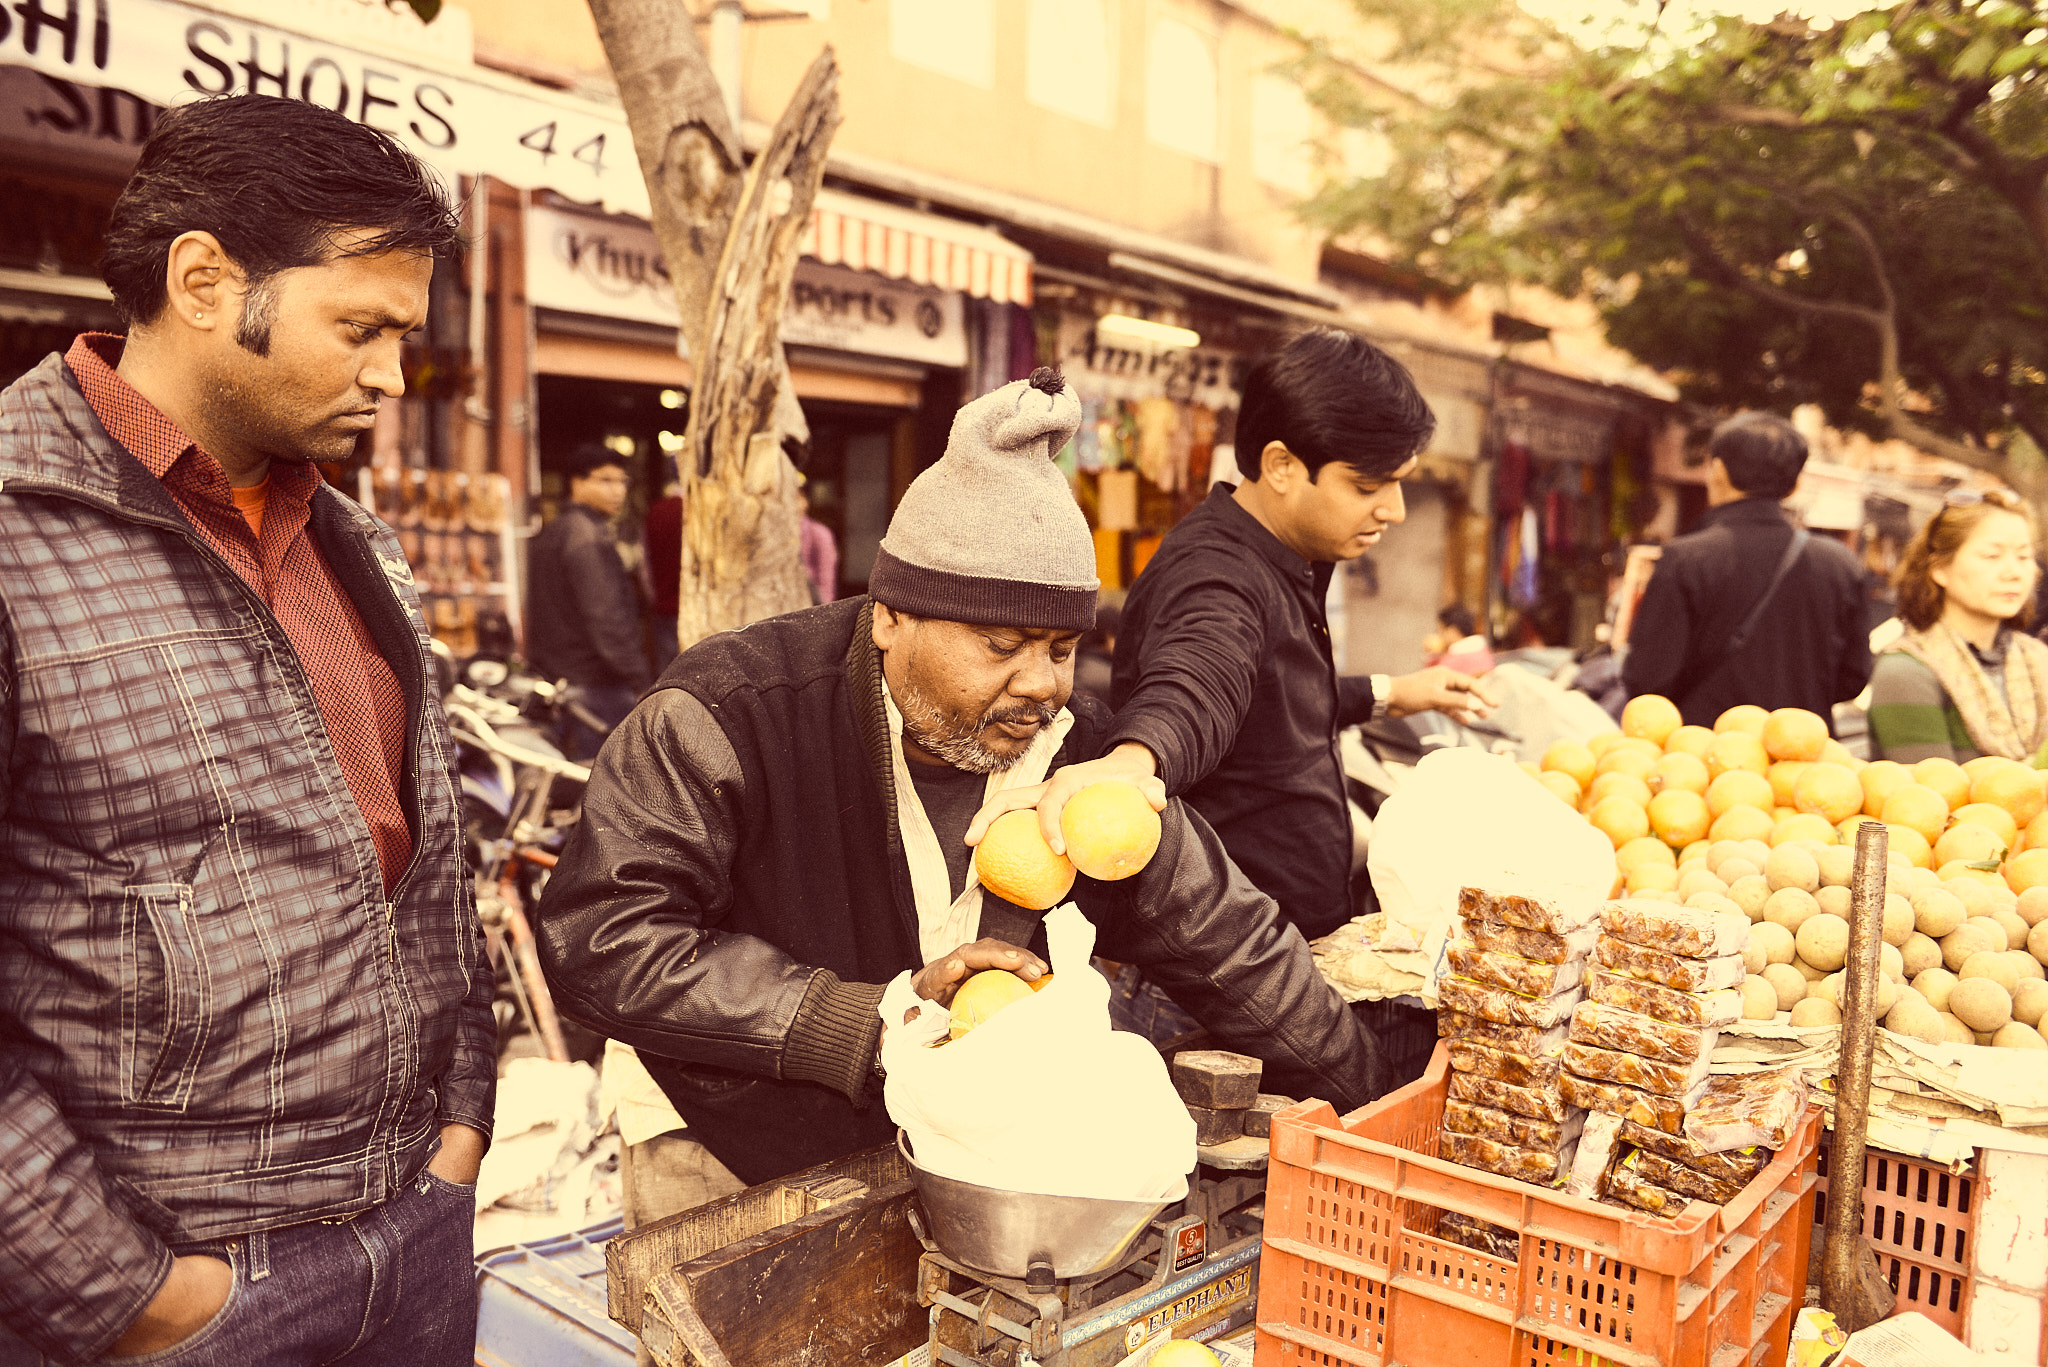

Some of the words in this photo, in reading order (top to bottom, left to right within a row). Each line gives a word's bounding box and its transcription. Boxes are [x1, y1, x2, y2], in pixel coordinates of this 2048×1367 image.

[182, 19, 457, 149] SHOES
[793, 280, 898, 326] ports
[1176, 1259, 1187, 1268] BEST
[1187, 1252, 1204, 1265] QUALITY
[1187, 1230, 1196, 1244] 5
[1147, 1270, 1250, 1335] ELEPHANT
